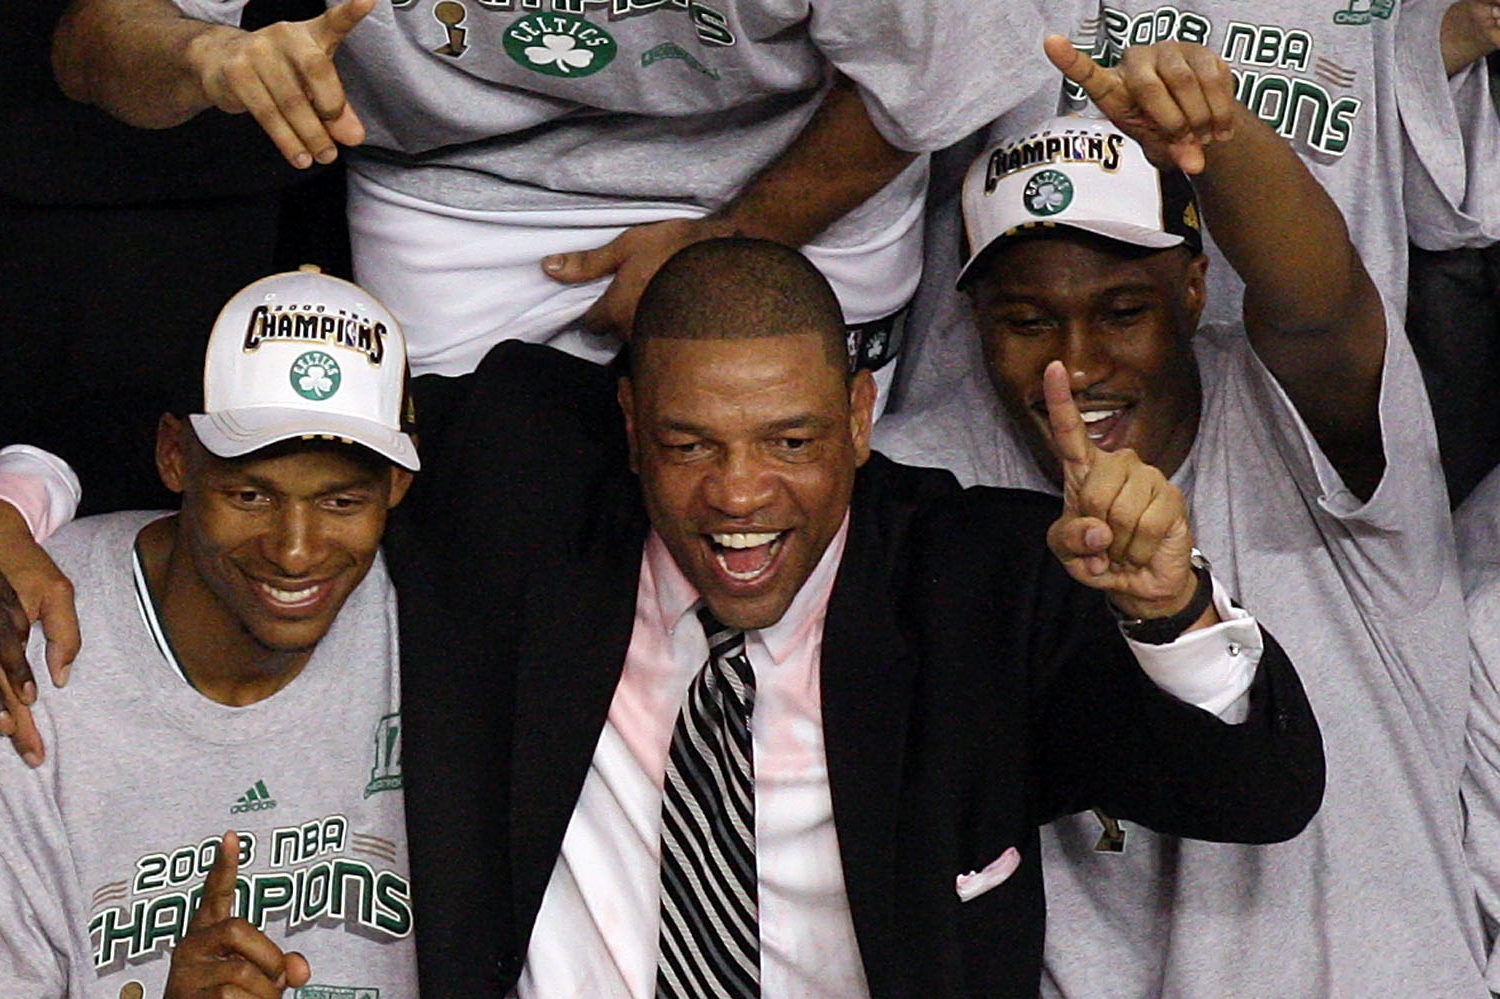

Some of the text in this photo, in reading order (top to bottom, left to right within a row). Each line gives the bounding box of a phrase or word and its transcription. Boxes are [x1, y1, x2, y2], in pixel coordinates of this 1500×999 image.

[509, 16, 609, 48] CELTICS
[1222, 21, 1314, 73] NBA
[230, 799, 278, 815] adidas
[270, 813, 349, 869] NBA
